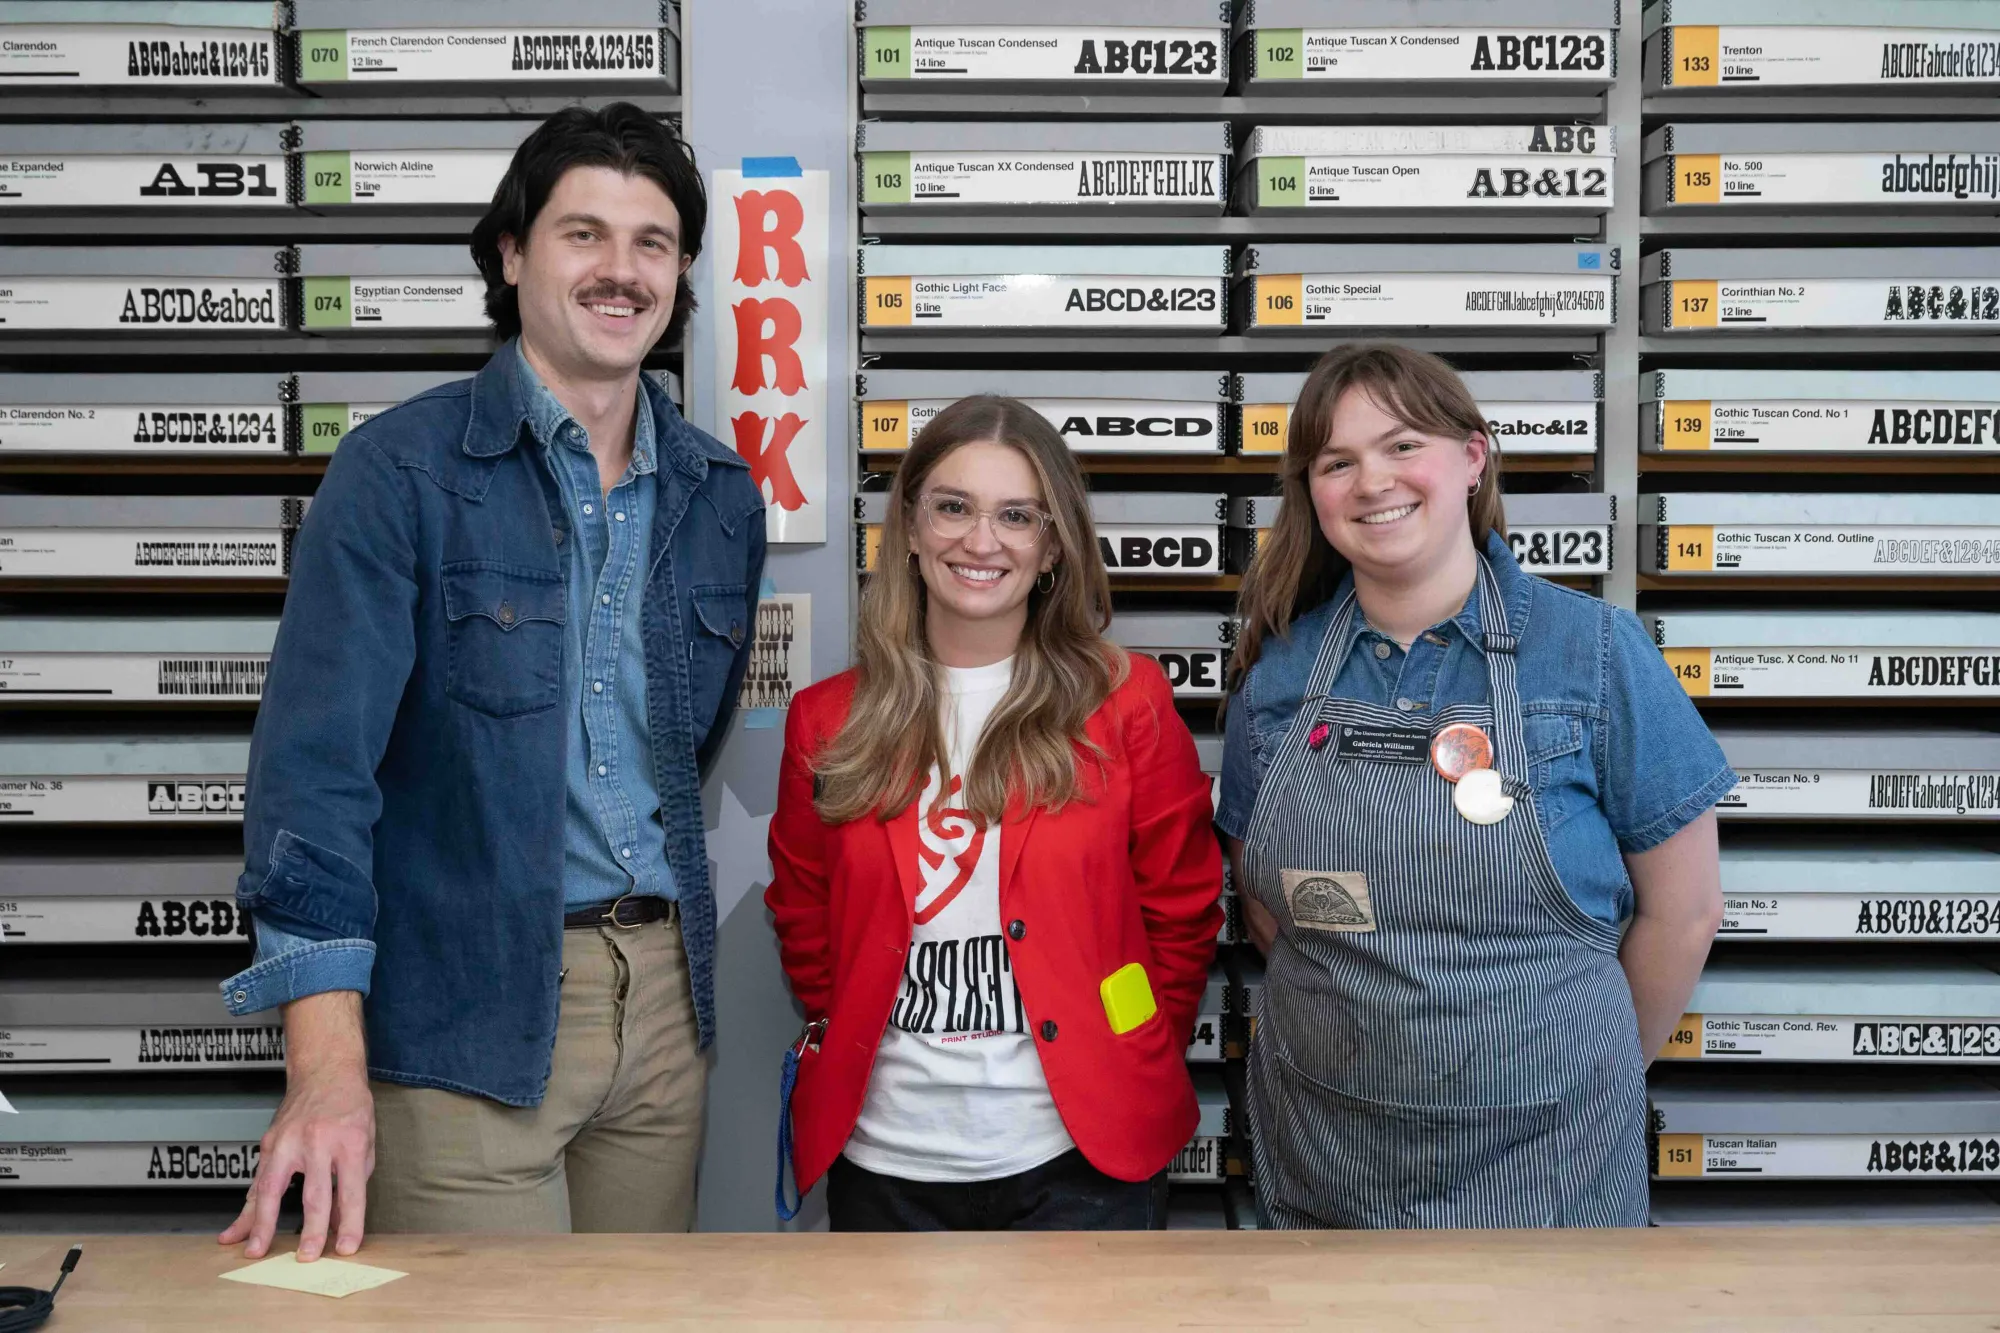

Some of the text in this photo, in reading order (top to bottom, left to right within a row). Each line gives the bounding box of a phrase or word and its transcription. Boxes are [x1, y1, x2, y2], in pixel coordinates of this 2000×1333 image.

[3, 41, 56, 50] Clarendon
[351, 36, 506, 46] French Clarendon Condensed
[915, 38, 1057, 49] Antique Tuscan Condensed
[1307, 36, 1459, 47] Antique Tuscan X Condensed
[312, 48, 338, 62] 070
[512, 35, 653, 70] ABCDEFG&123456
[876, 49, 899, 62] 101
[1074, 40, 1216, 74] ABC123
[1267, 47, 1293, 61] 102
[1471, 35, 1604, 70] ABC123
[1723, 46, 1762, 55] Trenton
[128, 41, 268, 76] ABCDabcd&12345
[366, 58, 382, 66] line
[929, 59, 945, 67] line
[1309, 57, 1337, 65] 10 line
[1683, 57, 1709, 71] 133
[1724, 66, 1753, 74] 10 line
[1525, 123, 1599, 153] ABC
[12, 162, 63, 173] Expanded
[355, 162, 433, 171] Norwich Aldine
[915, 162, 1074, 174] Antique Tuscan XX Condensed
[1310, 166, 1419, 177] Antique Tuscan Open
[1725, 162, 1762, 170] No. 500
[140, 163, 276, 196] AB1
[315, 172, 341, 186] 072
[875, 174, 901, 188] 103
[1078, 160, 1214, 196] ABCDEFGHIJK
[1270, 177, 1296, 191] 104
[1467, 169, 1605, 198] AB&12
[1685, 172, 1710, 186] 135
[916, 183, 945, 191] 10 line
[1725, 182, 1754, 190] 10 line
[733, 190, 811, 287] R
[355, 286, 463, 297] Egyptian Condensed
[916, 283, 1006, 294] Gothic Light Face
[1306, 285, 1381, 296] Gothic Special
[1722, 287, 1804, 296] Corinthian No. 2
[119, 288, 274, 323] ABCD&abcd
[315, 296, 342, 310] 074
[876, 294, 902, 307] 105
[1065, 288, 1215, 311] ABCD&123
[1267, 296, 1293, 309] 106
[1682, 298, 1708, 312] 137
[1884, 286, 1999, 320] ABC&12
[1736, 307, 1752, 315] line
[731, 298, 807, 396] R
[10, 409, 94, 419] Clarendon No. 2
[1715, 408, 1749, 417] Gothic
[1752, 409, 1789, 417] Tuscan
[1792, 409, 1822, 417] Cond.
[1826, 409, 1840, 418] No
[134, 413, 276, 443] ABCDE&1234
[313, 422, 340, 436] 076
[873, 418, 898, 432] 107
[1060, 417, 1213, 436] ABCD
[1252, 422, 1278, 435] 108
[1675, 418, 1701, 432] 139
[1716, 428, 1744, 436] 12 line
[731, 410, 810, 512] K
[1717, 533, 1874, 542] Gothic Tuscan X Cond. Outline
[1101, 537, 1212, 567] ABCD
[1508, 530, 1603, 565] C&123
[1678, 543, 1701, 557] 141
[1715, 654, 1858, 665] Antique Tusc. X Cond. No 11
[1158, 653, 1216, 687] DE
[1674, 665, 1701, 679] 143
[1753, 774, 1819, 783] Tuscan No. 9
[30, 782, 48, 790] No.
[50, 782, 63, 790] 36
[1751, 900, 1768, 908] No.
[1771, 900, 1777, 908] 2
[1706, 1021, 1837, 1031] Gothic Tuscan Cond. Rev.
[941, 1030, 1003, 1044] PRINT STUDIO
[1854, 1023, 2000, 1056] ABC&123
[1707, 1040, 1736, 1048] 15 line
[1707, 1139, 1776, 1148] Tuscan Italian
[20, 1146, 66, 1156] Egyptian
[1668, 1149, 1691, 1162] 151
[1867, 1139, 2000, 1172] ABCE&123
